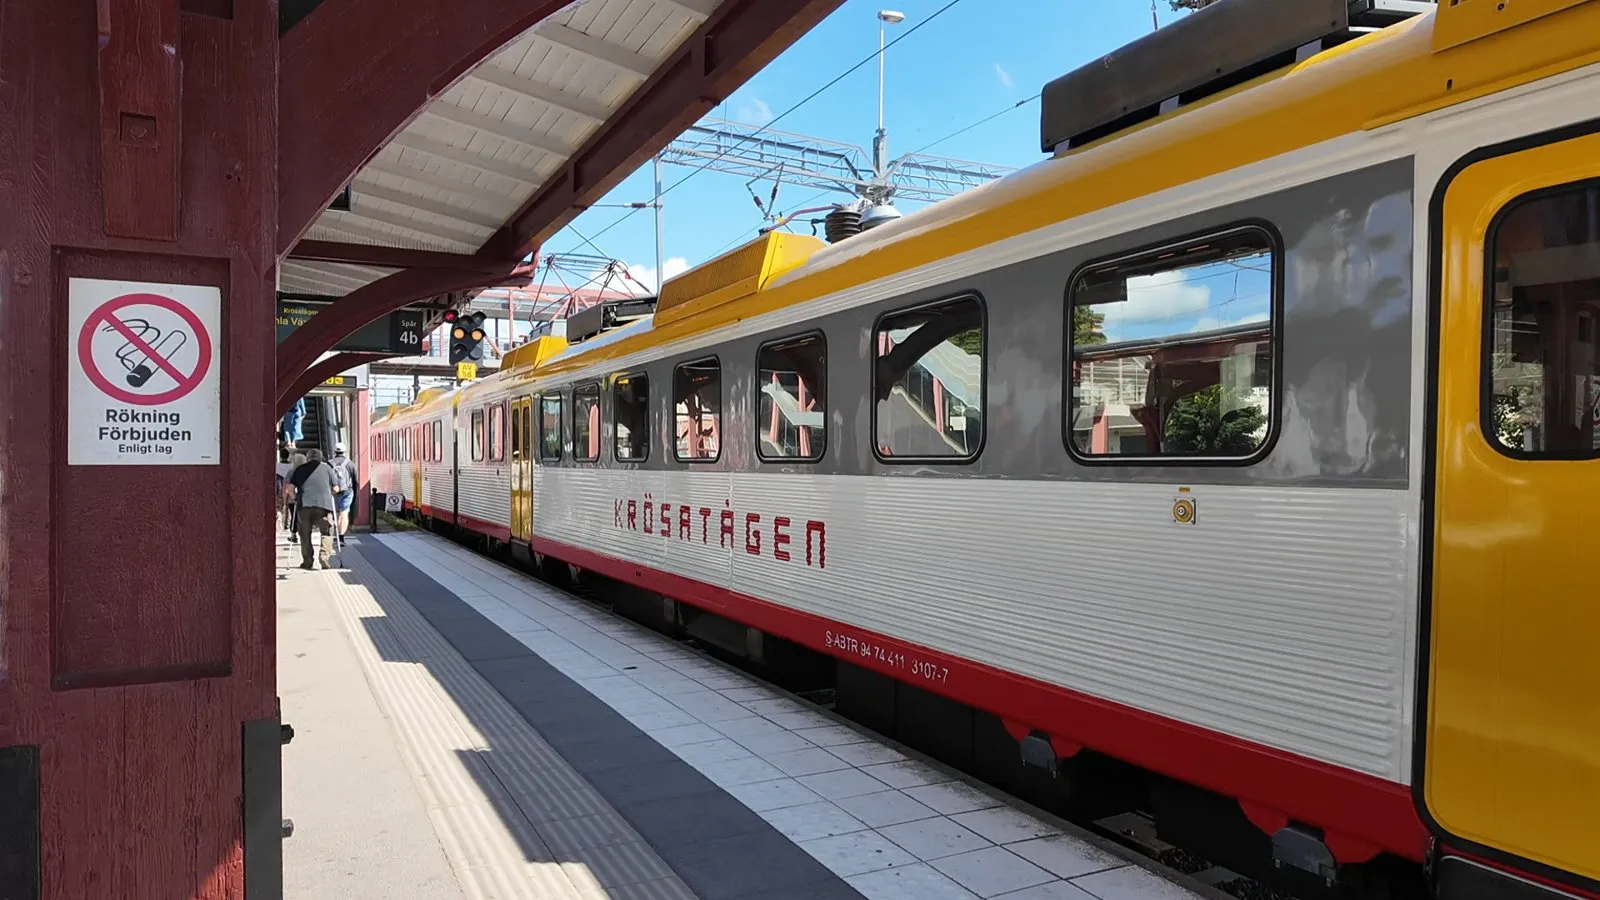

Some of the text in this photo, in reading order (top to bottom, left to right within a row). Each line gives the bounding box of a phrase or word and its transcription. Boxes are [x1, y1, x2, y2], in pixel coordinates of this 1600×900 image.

[401, 319, 417, 329] Spår
[399, 331, 418, 345] 4b
[105, 408, 181, 426] Rökning
[98, 426, 192, 443] Förbjuden
[118, 443, 173, 455] Enligt lag
[614, 492, 826, 570] KRÖSATÅGEN
[860, 642, 872, 657] 94
[873, 646, 885, 661] 74
[887, 651, 905, 669] 411
[911, 659, 949, 684] 3107-7
